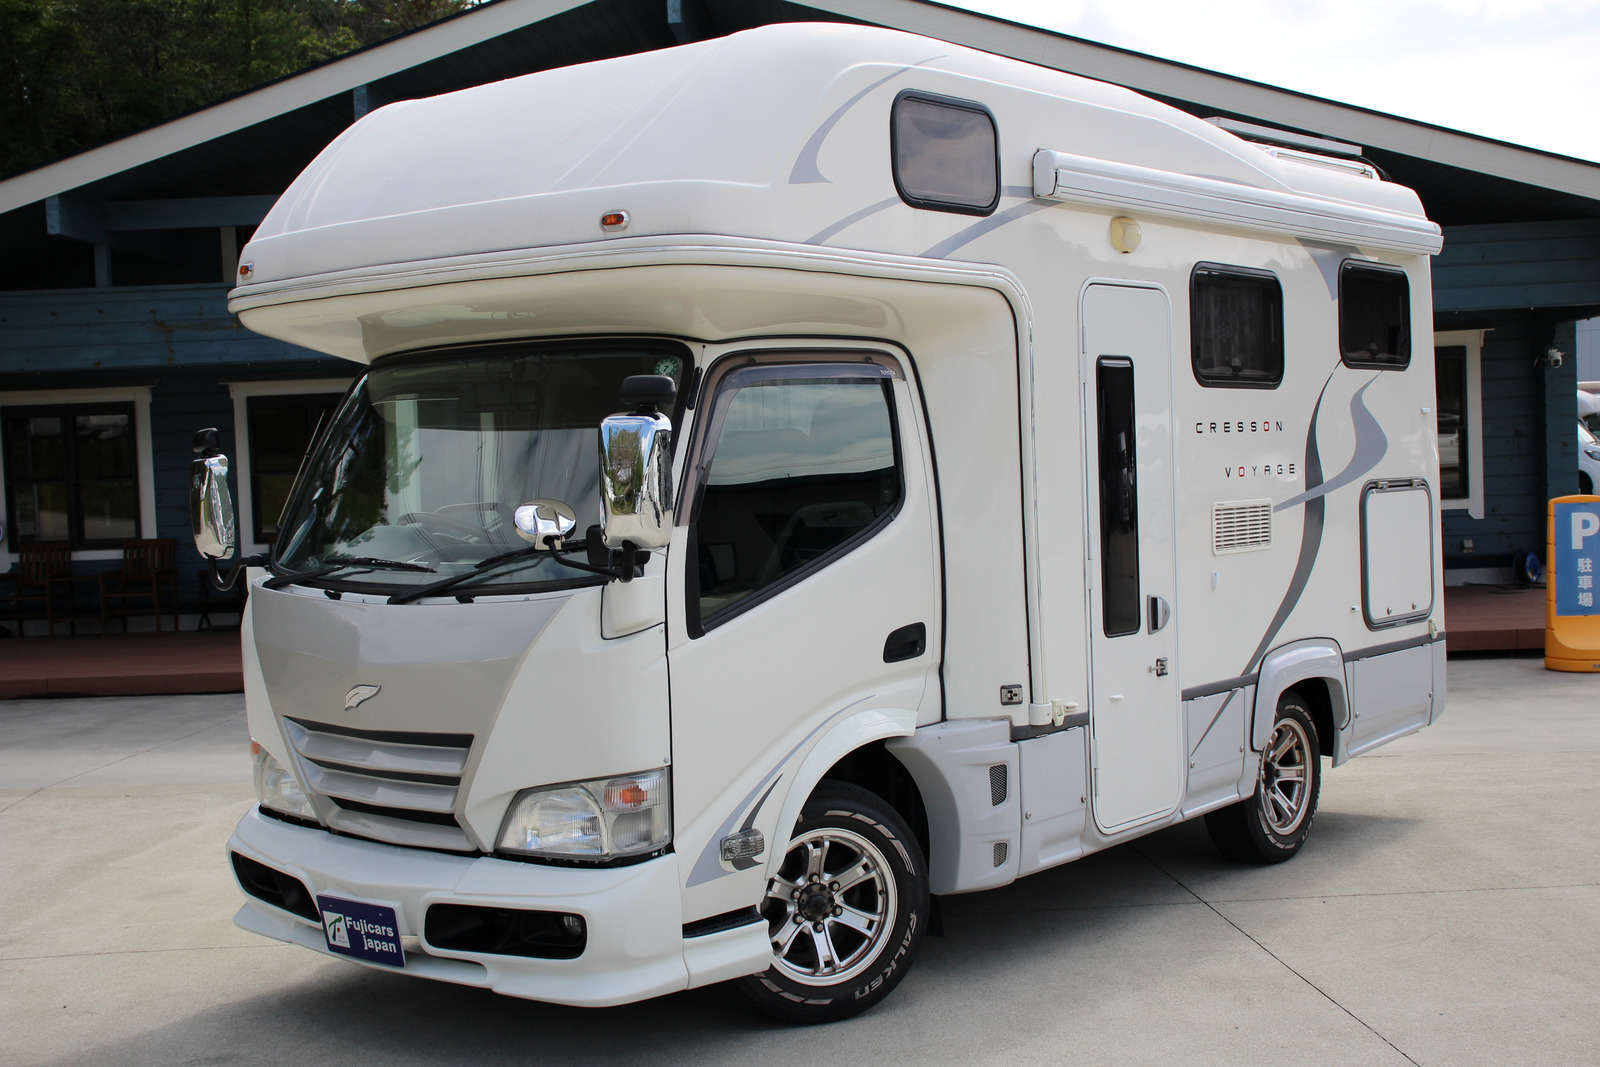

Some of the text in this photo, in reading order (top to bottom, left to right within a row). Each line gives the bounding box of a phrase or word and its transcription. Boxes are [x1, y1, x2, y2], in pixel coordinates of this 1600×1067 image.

[1195, 421, 1283, 434] CRESSON
[1224, 463, 1295, 478] VOYAGE
[1571, 512, 1600, 550] P
[1577, 557, 1593, 608] 駐車場
[345, 916, 395, 937] Fujicars
[363, 935, 397, 953] japan
